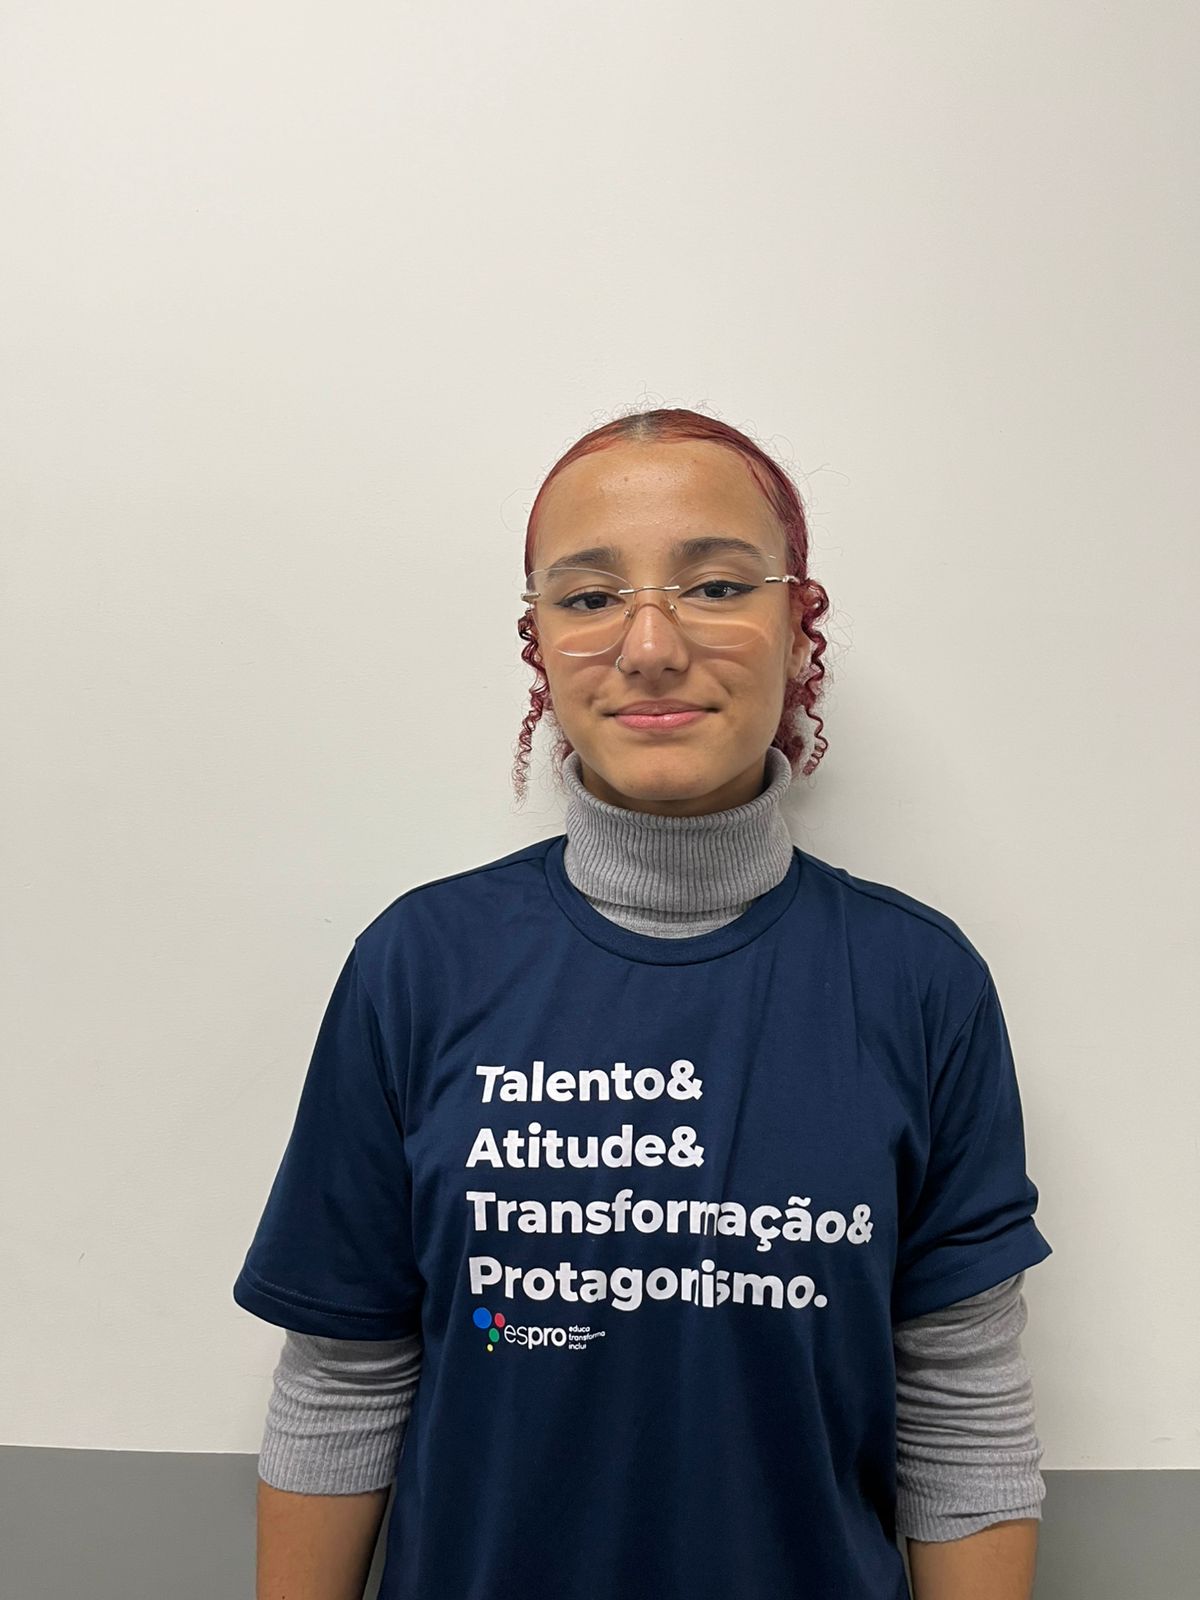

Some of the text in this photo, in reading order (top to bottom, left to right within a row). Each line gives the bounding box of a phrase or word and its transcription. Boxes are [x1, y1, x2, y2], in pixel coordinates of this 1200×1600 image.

[476, 1060, 703, 1104] Talento&
[466, 1122, 704, 1168] Atitude&
[466, 1189, 873, 1251] Transformação&
[504, 1325, 567, 1350] espro
[568, 1331, 606, 1341] transforma
